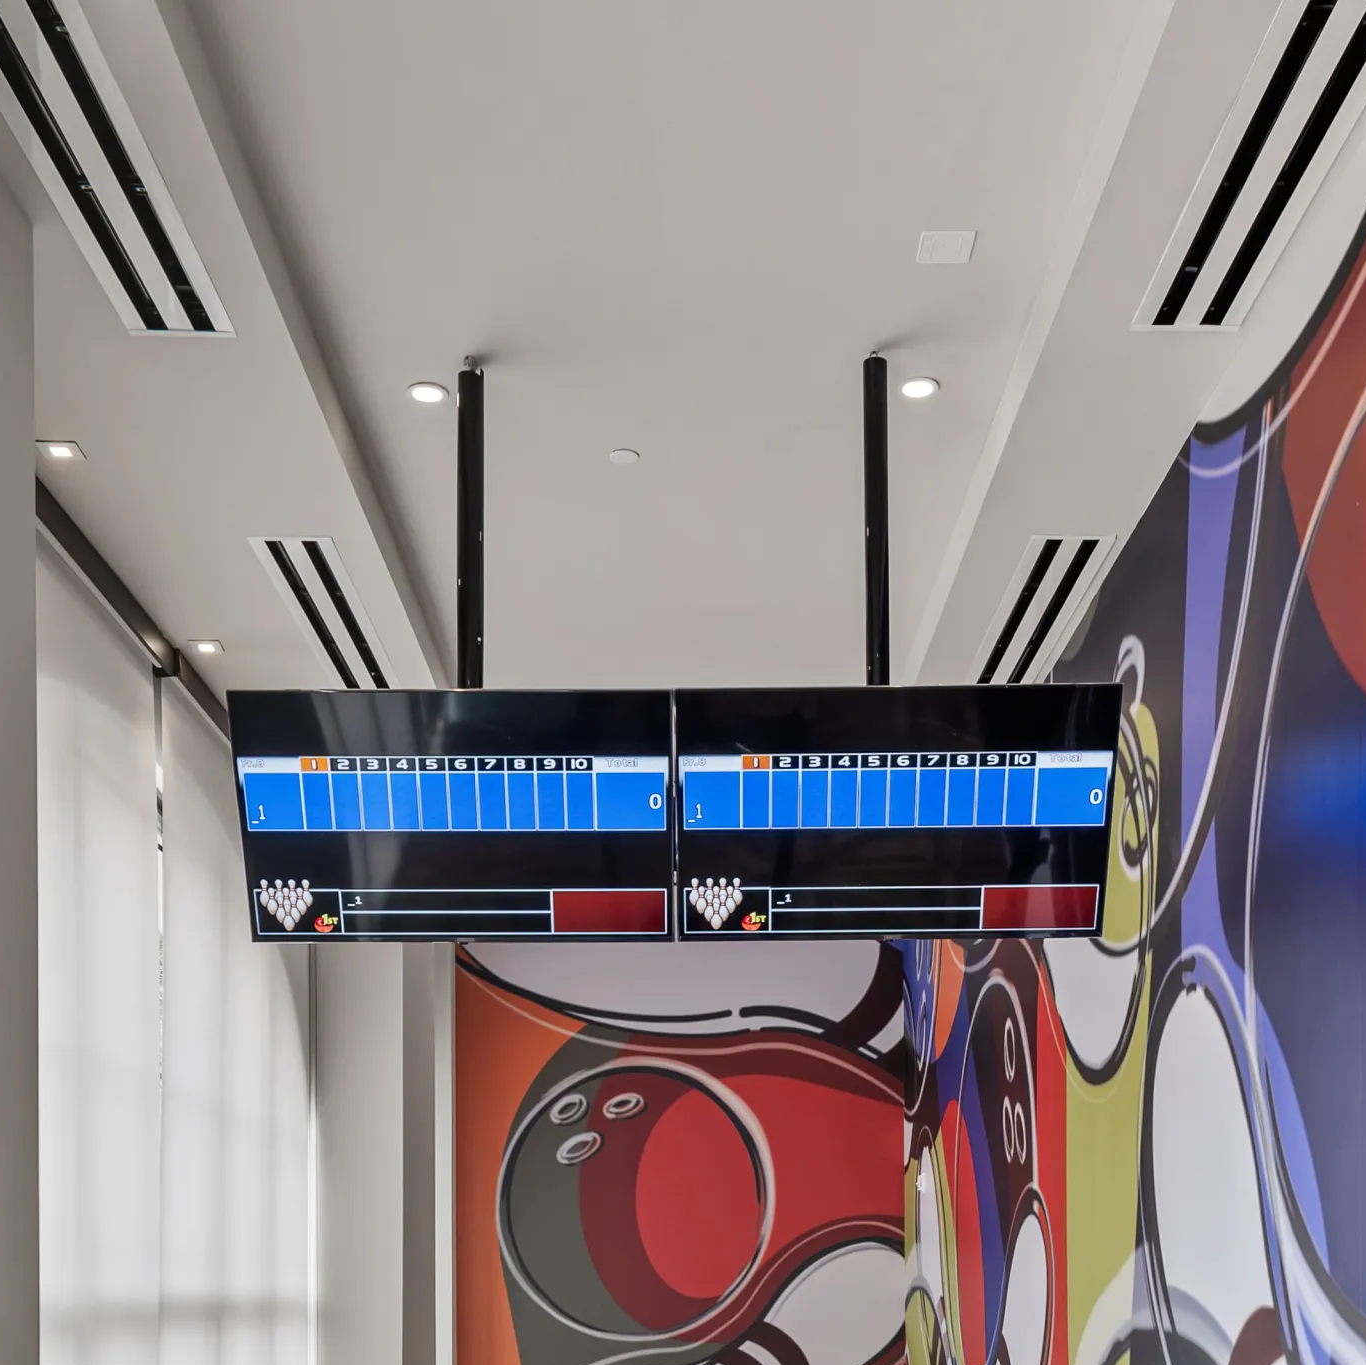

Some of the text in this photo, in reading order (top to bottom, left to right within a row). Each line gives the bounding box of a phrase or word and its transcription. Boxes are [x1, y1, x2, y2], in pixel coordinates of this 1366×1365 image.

[311, 759, 318, 770] 1
[337, 759, 350, 770] 2
[367, 759, 380, 770] 3
[396, 759, 408, 770] 4
[425, 759, 438, 770] 5
[454, 759, 467, 770] 6
[484, 759, 497, 770] 7
[513, 759, 526, 770] 8
[543, 759, 556, 770] 9
[571, 759, 588, 770] 10
[606, 758, 638, 768] Total
[753, 757, 760, 768] 1
[779, 756, 792, 767] 2
[808, 756, 821, 767] 3
[838, 756, 851, 767] 4
[867, 756, 881, 767] 5
[896, 756, 910, 766] 6
[927, 755, 940, 766] 7
[956, 755, 969, 766] 8
[987, 754, 1000, 765] 9
[1014, 754, 1031, 765] 10
[1049, 753, 1082, 763] Total
[648, 793, 662, 810] 0
[1089, 788, 1103, 805] 0
[750, 911, 767, 923] 1ST
